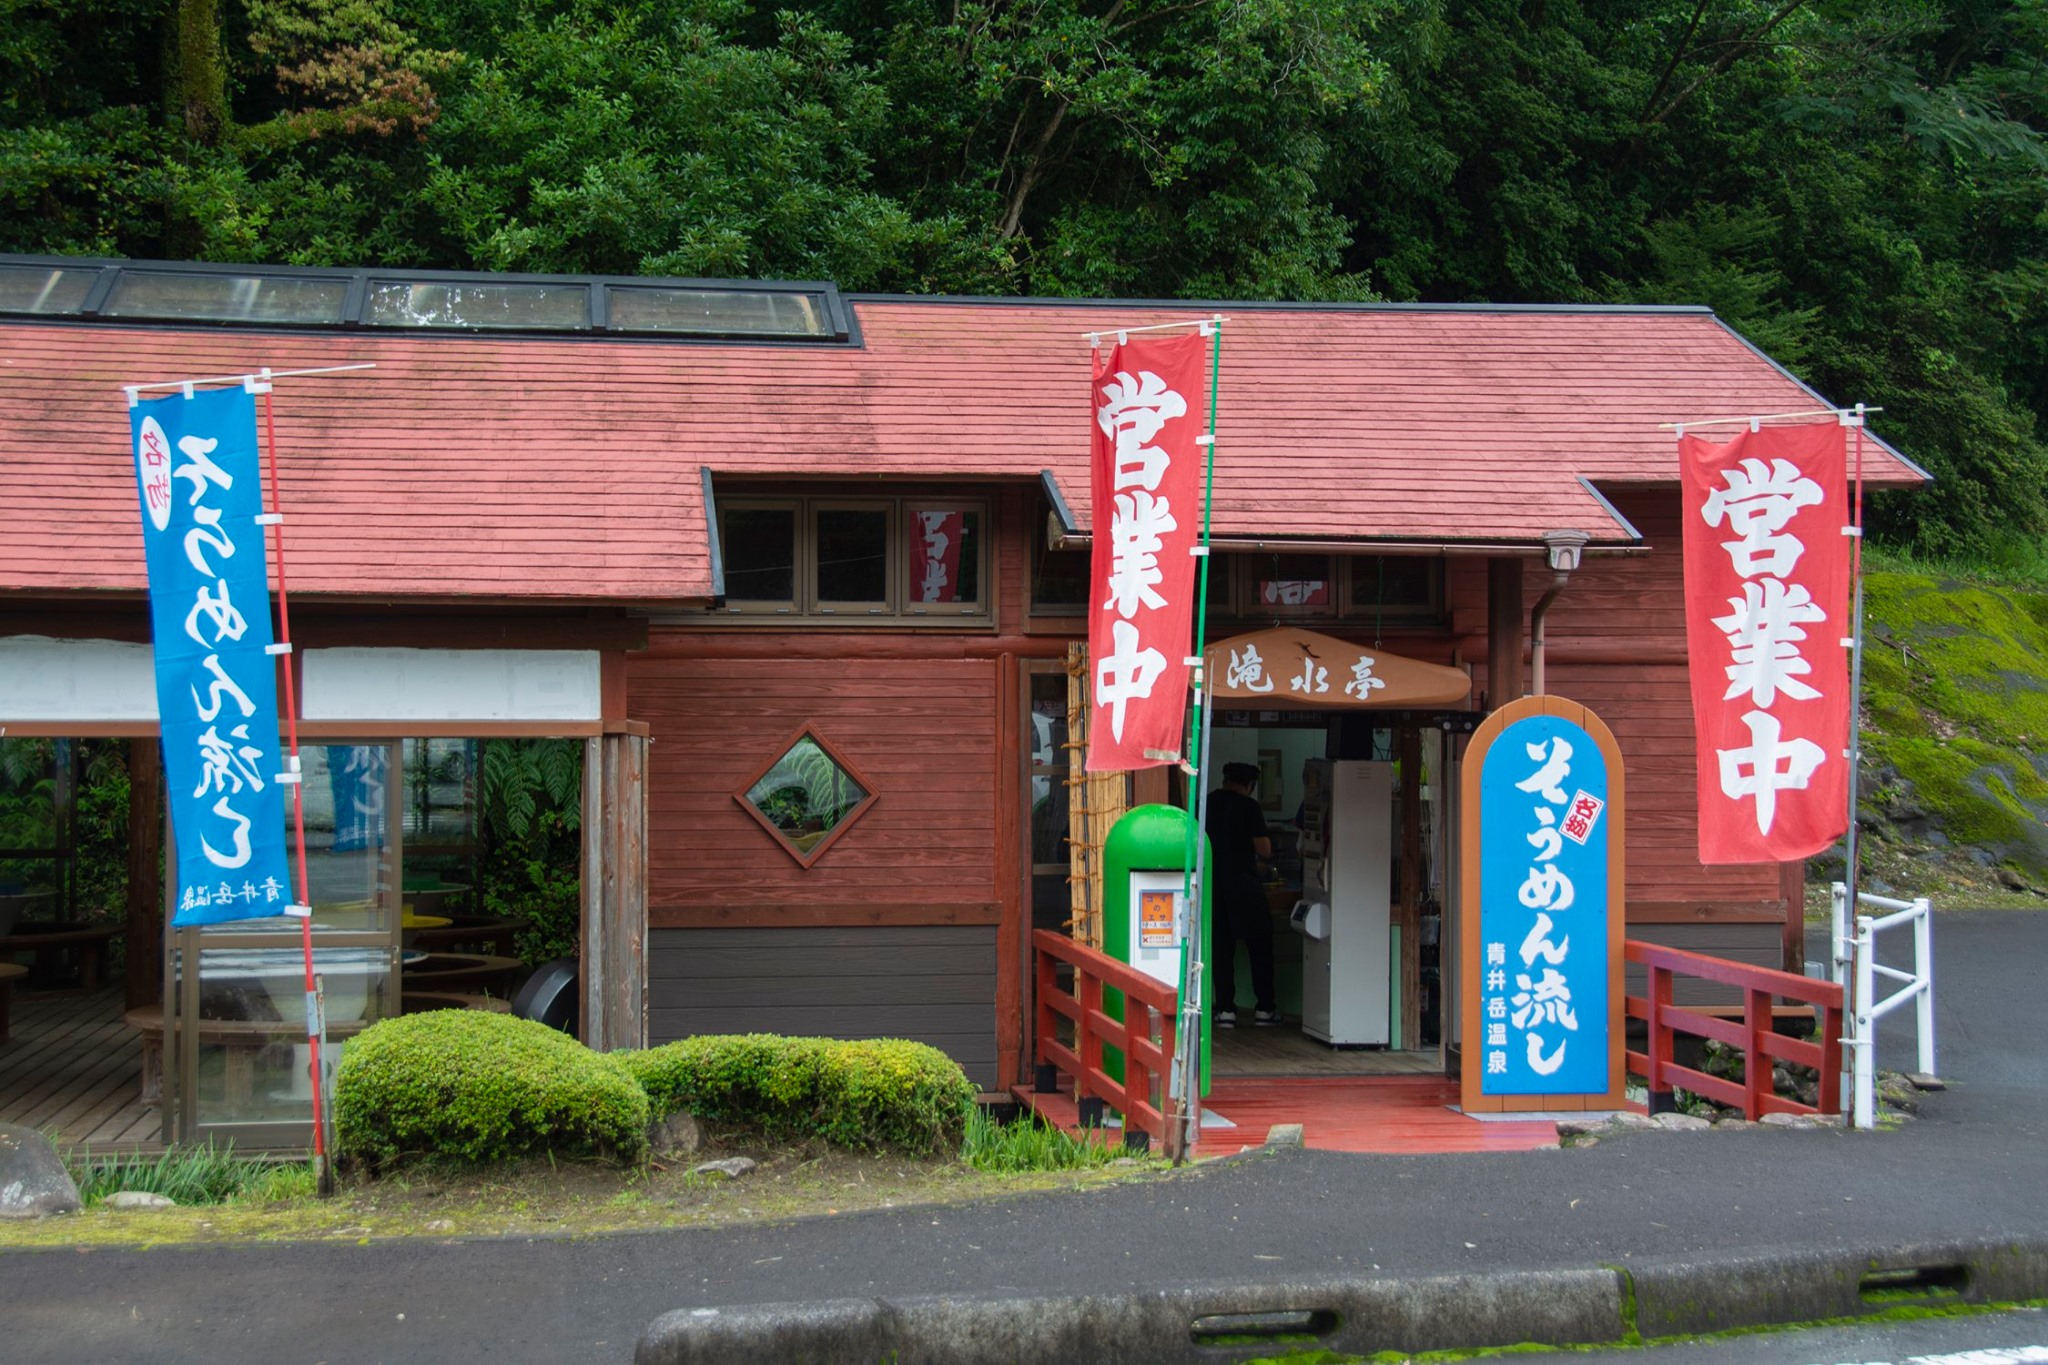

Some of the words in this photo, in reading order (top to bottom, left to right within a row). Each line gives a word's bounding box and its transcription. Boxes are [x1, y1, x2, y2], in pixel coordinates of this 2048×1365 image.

[1096, 370, 1187, 745] 営業中
[1227, 644, 1386, 700] 滝水亭
[1700, 457, 1827, 837] 営業中
[1566, 797, 1597, 838] 名物
[1153, 904, 1161, 912] の
[1511, 736, 1579, 1075] そうめん流し
[1487, 942, 1507, 1074] 青井岳温泉
